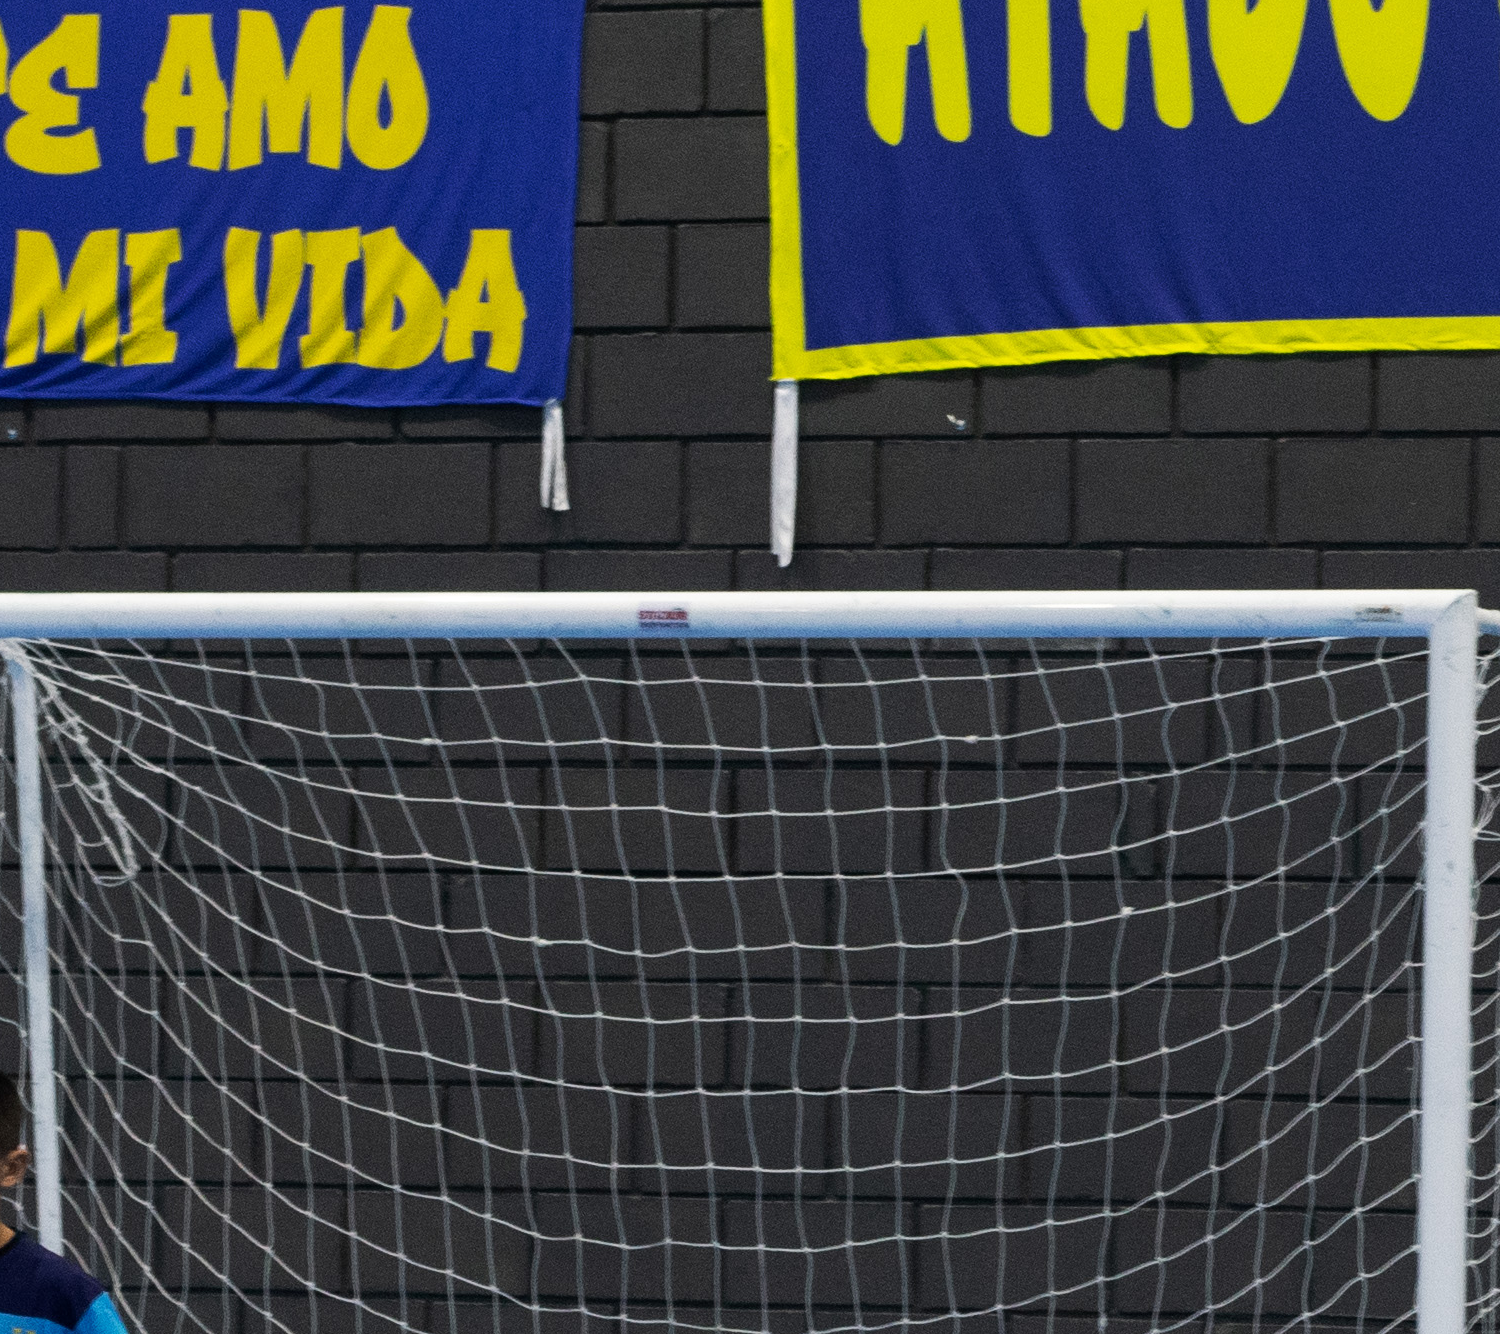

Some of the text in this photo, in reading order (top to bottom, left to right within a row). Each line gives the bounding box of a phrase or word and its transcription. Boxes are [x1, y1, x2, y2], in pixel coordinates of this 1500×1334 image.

[142, 5, 430, 171] AMO
[4, 227, 182, 369] MI
[223, 226, 527, 373] VIDA
